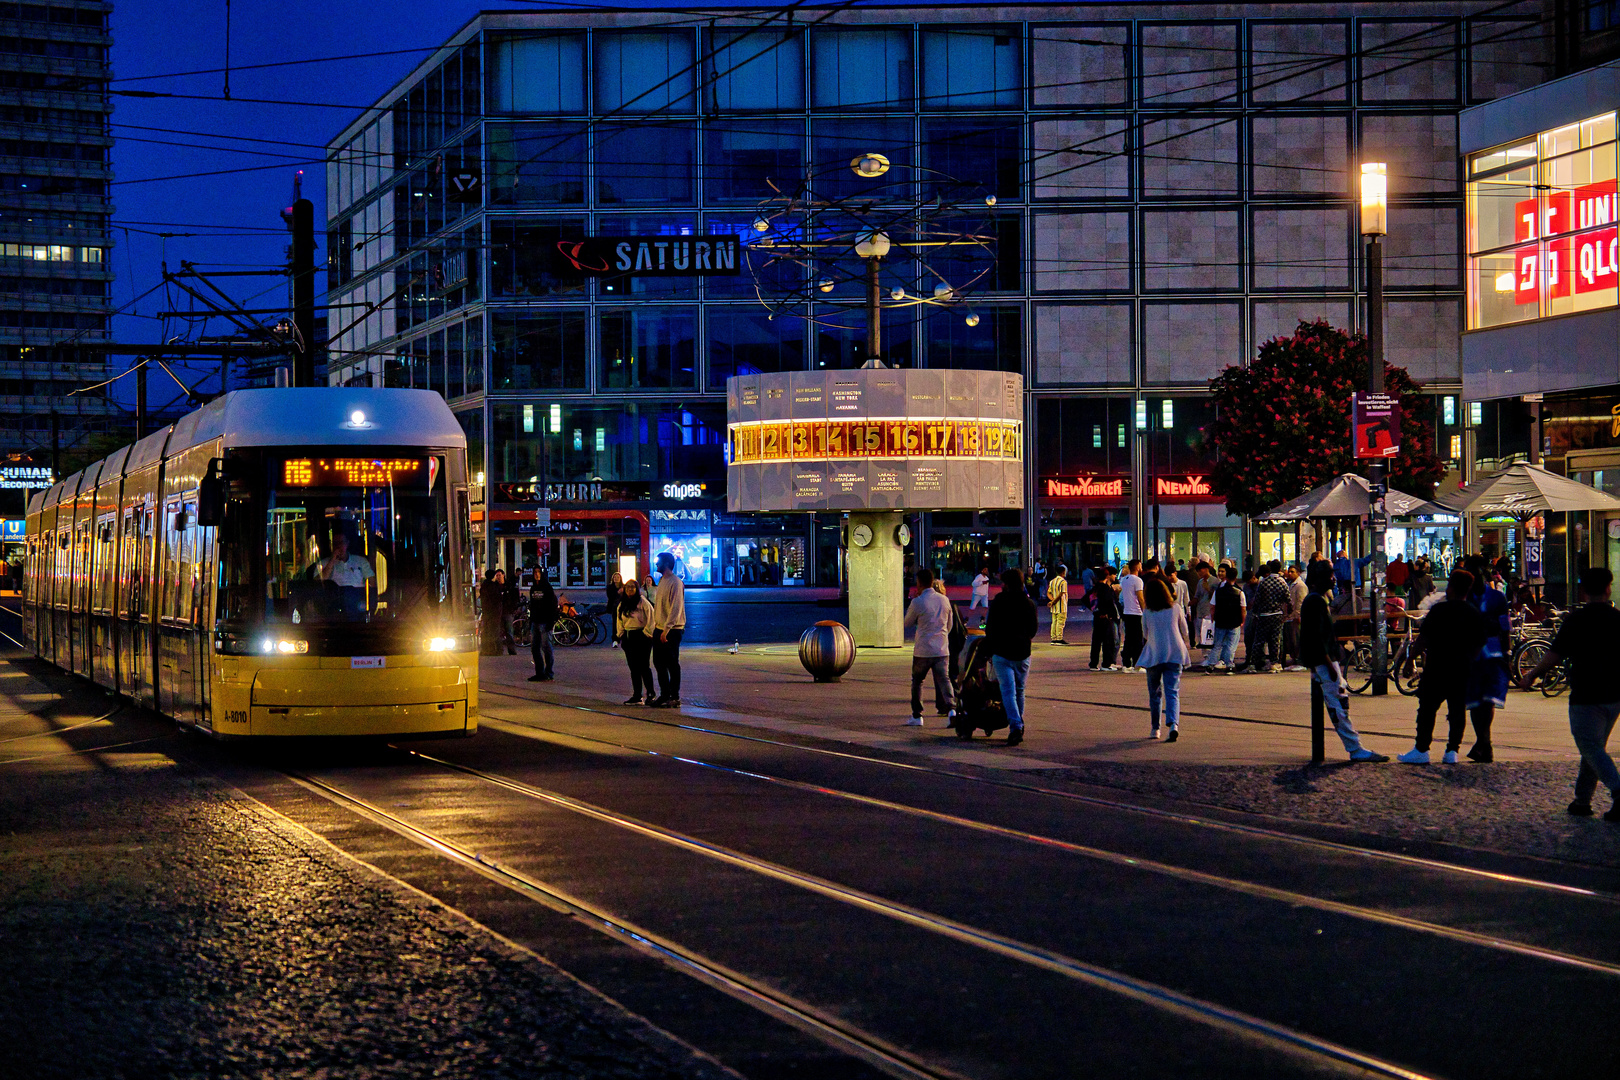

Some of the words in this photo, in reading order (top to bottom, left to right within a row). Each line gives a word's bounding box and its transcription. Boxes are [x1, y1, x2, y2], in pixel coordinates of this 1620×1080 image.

[616, 241, 735, 271] SATURN
[784, 428, 807, 452] 13
[816, 427, 842, 451] 14
[853, 427, 881, 451] 15
[890, 426, 919, 450] 16
[927, 426, 953, 450] 17
[960, 427, 981, 450] 18
[985, 427, 1001, 451] 19
[533, 483, 602, 501] SATURN
[663, 484, 702, 501] snipes
[1048, 477, 1122, 496] NEWYORKER
[9, 521, 20, 533] U
[225, 710, 247, 723] A-8010
